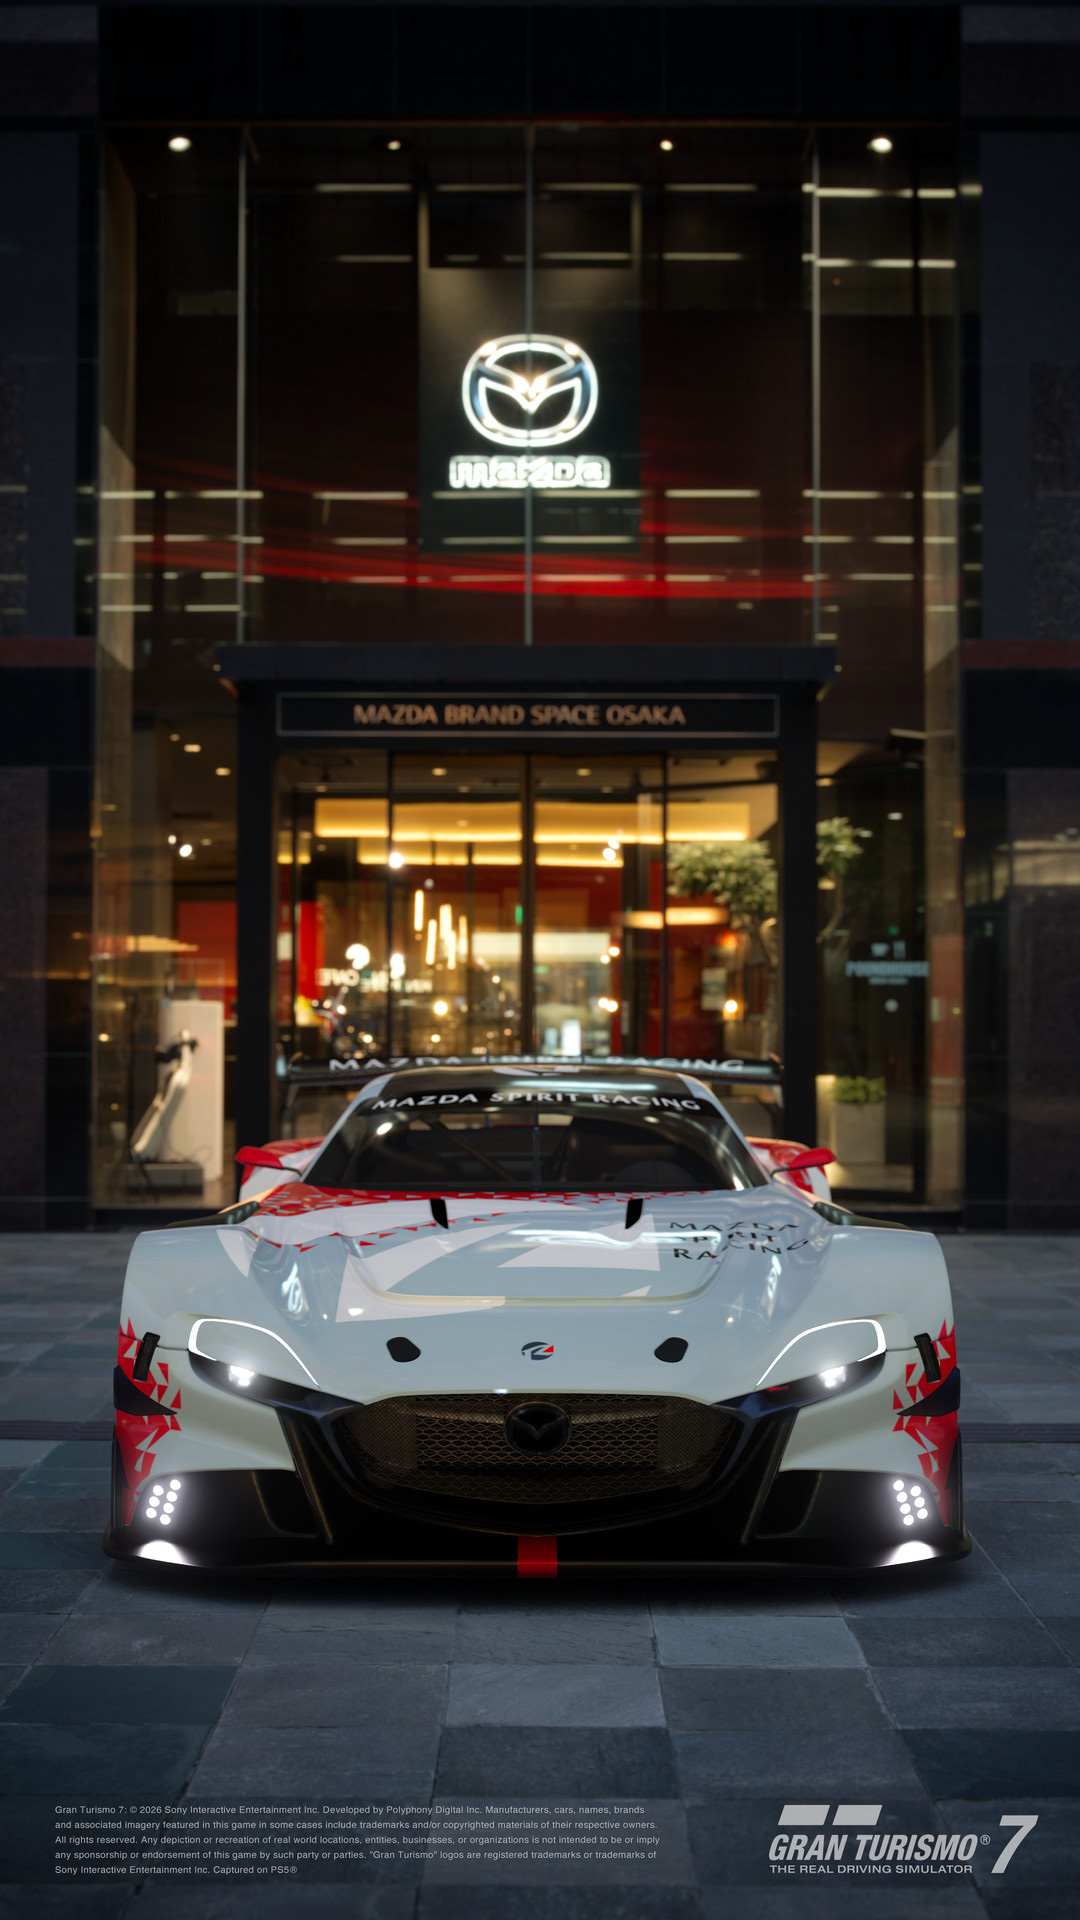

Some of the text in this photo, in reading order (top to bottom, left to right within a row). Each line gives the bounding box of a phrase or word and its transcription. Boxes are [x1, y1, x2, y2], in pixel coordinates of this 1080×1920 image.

[353, 704, 687, 725] MAZDA BRAND SPACE OSAKA
[371, 1092, 702, 1111] MAZDA SPIRIT RACING
[669, 1221, 800, 1232] MAZDA
[673, 1238, 809, 1260] RACING
